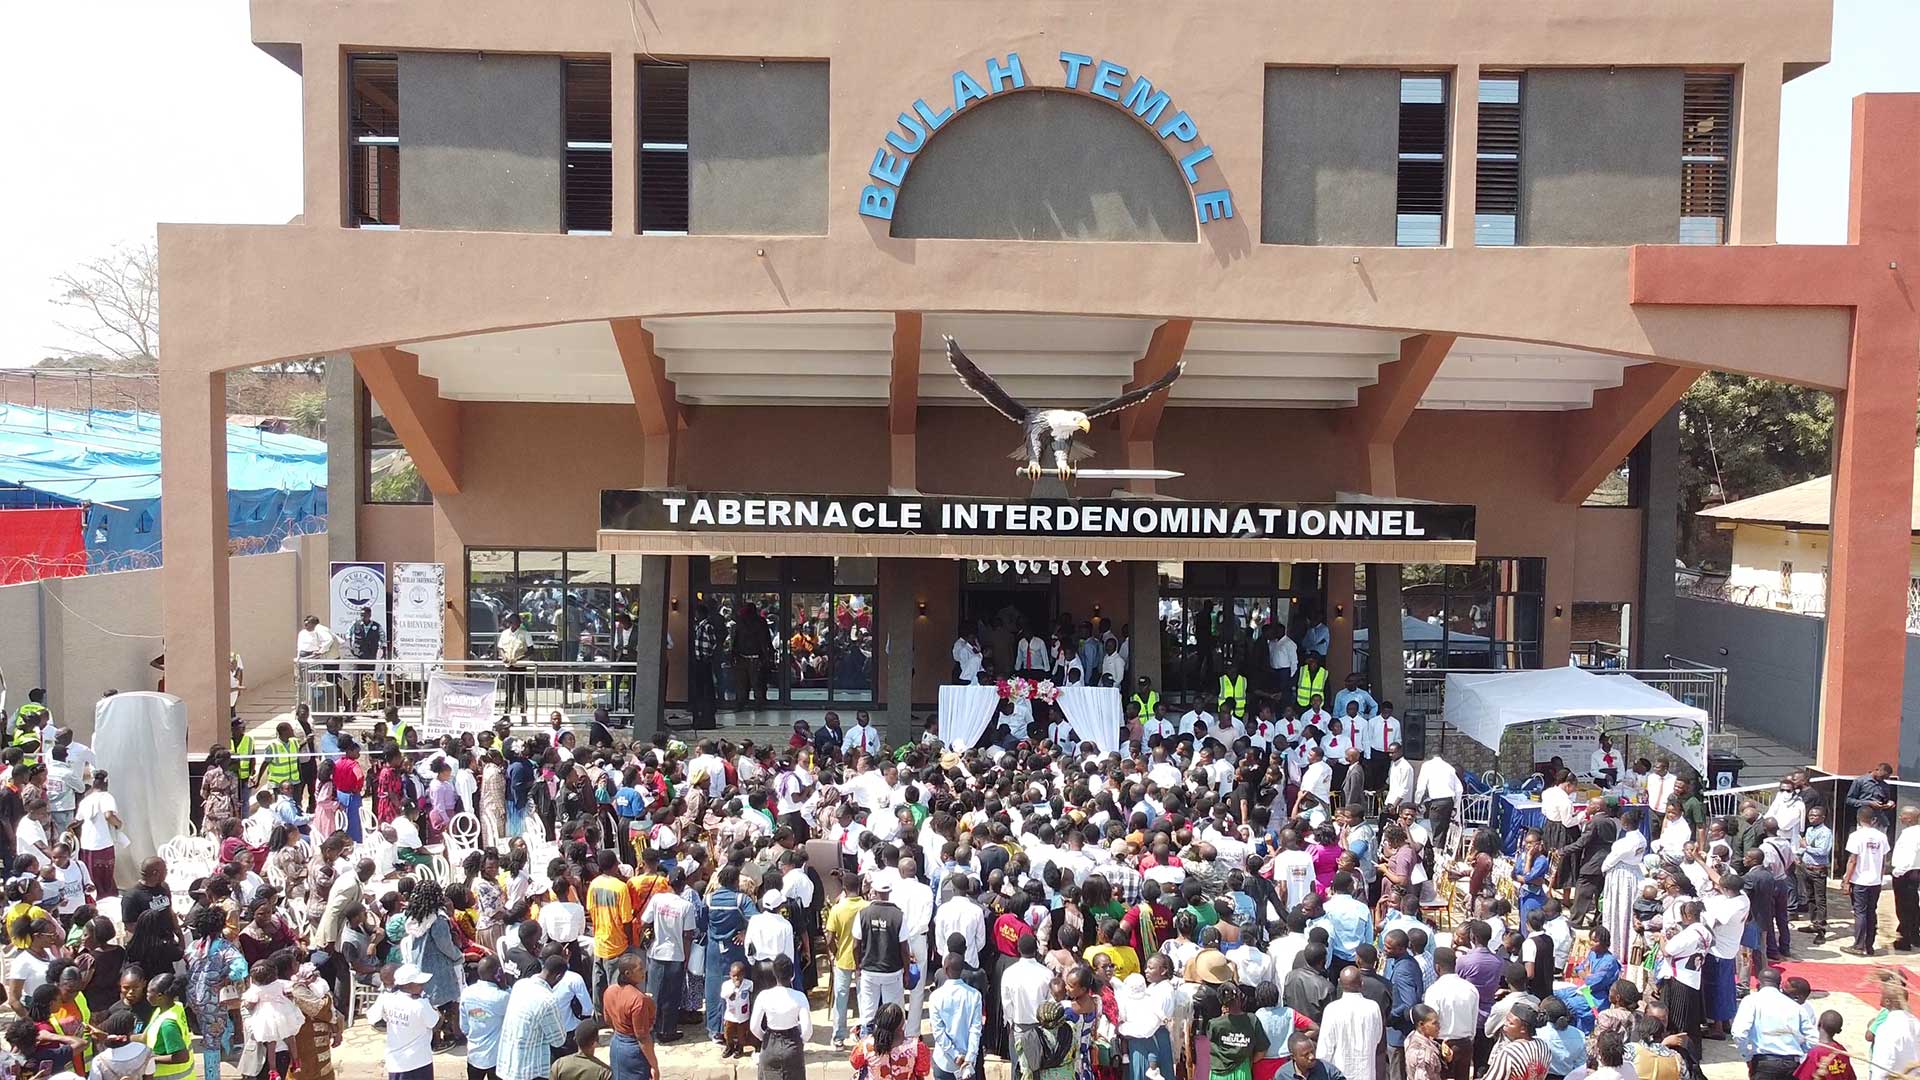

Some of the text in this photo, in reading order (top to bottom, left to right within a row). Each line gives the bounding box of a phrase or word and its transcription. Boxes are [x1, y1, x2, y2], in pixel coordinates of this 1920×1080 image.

[858, 51, 1233, 224] BEULAH TEMPLE
[662, 498, 1425, 536] TABERNACLE INTERDENOMINATIONNEL
